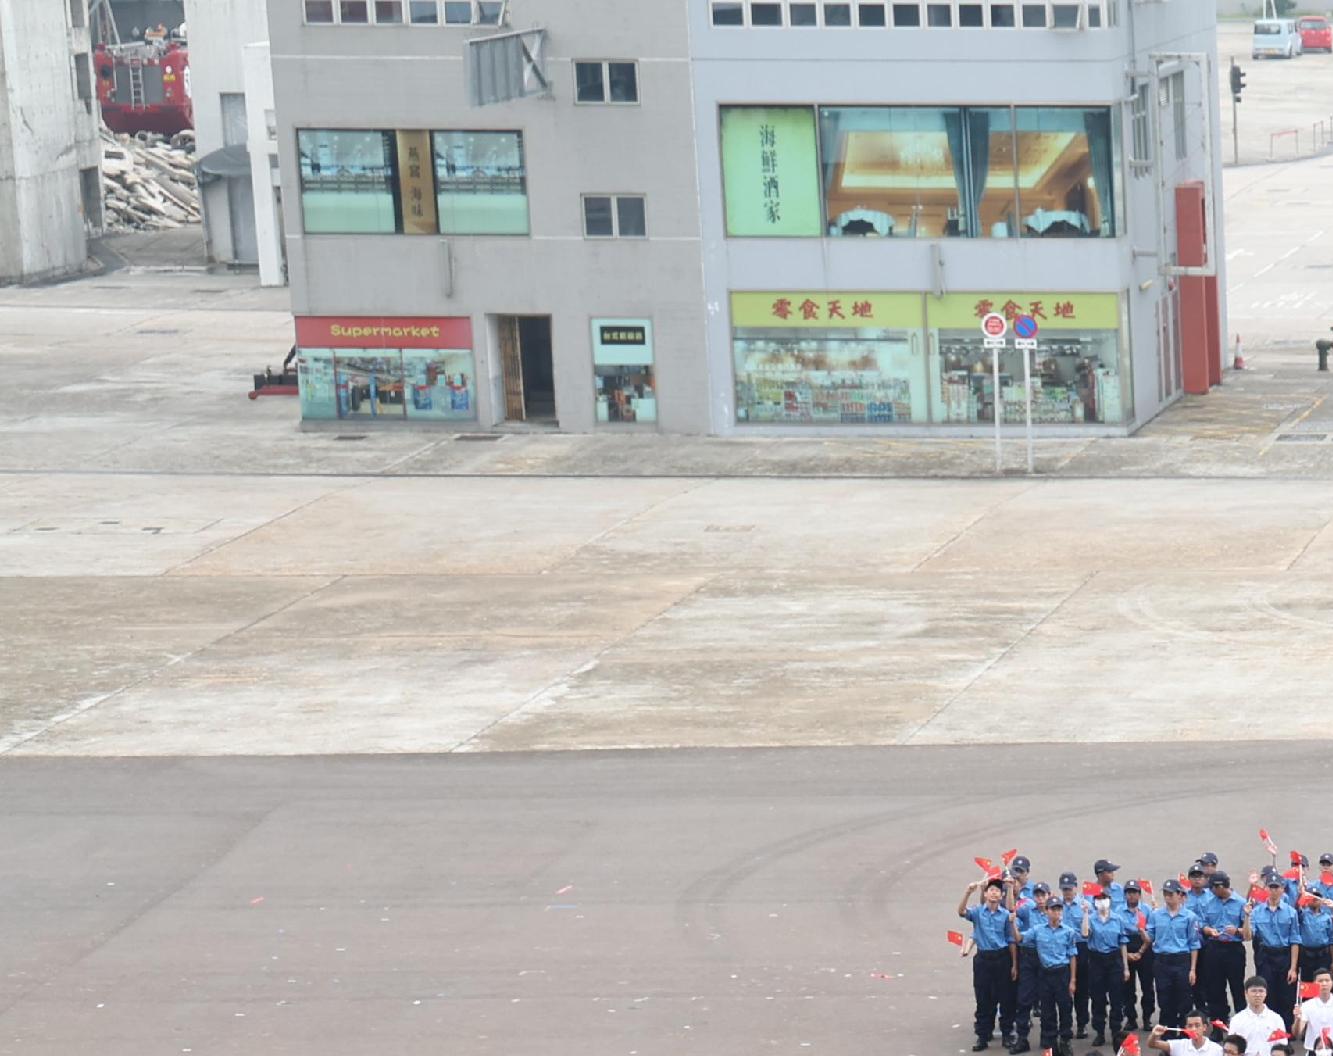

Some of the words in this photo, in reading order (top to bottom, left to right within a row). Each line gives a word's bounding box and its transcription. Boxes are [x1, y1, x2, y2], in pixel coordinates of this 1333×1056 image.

[759, 124, 781, 224] 海鮮酒家
[771, 298, 874, 320] 零食天地
[974, 299, 1076, 320] 零食天地
[330, 324, 440, 339] Supermarket
